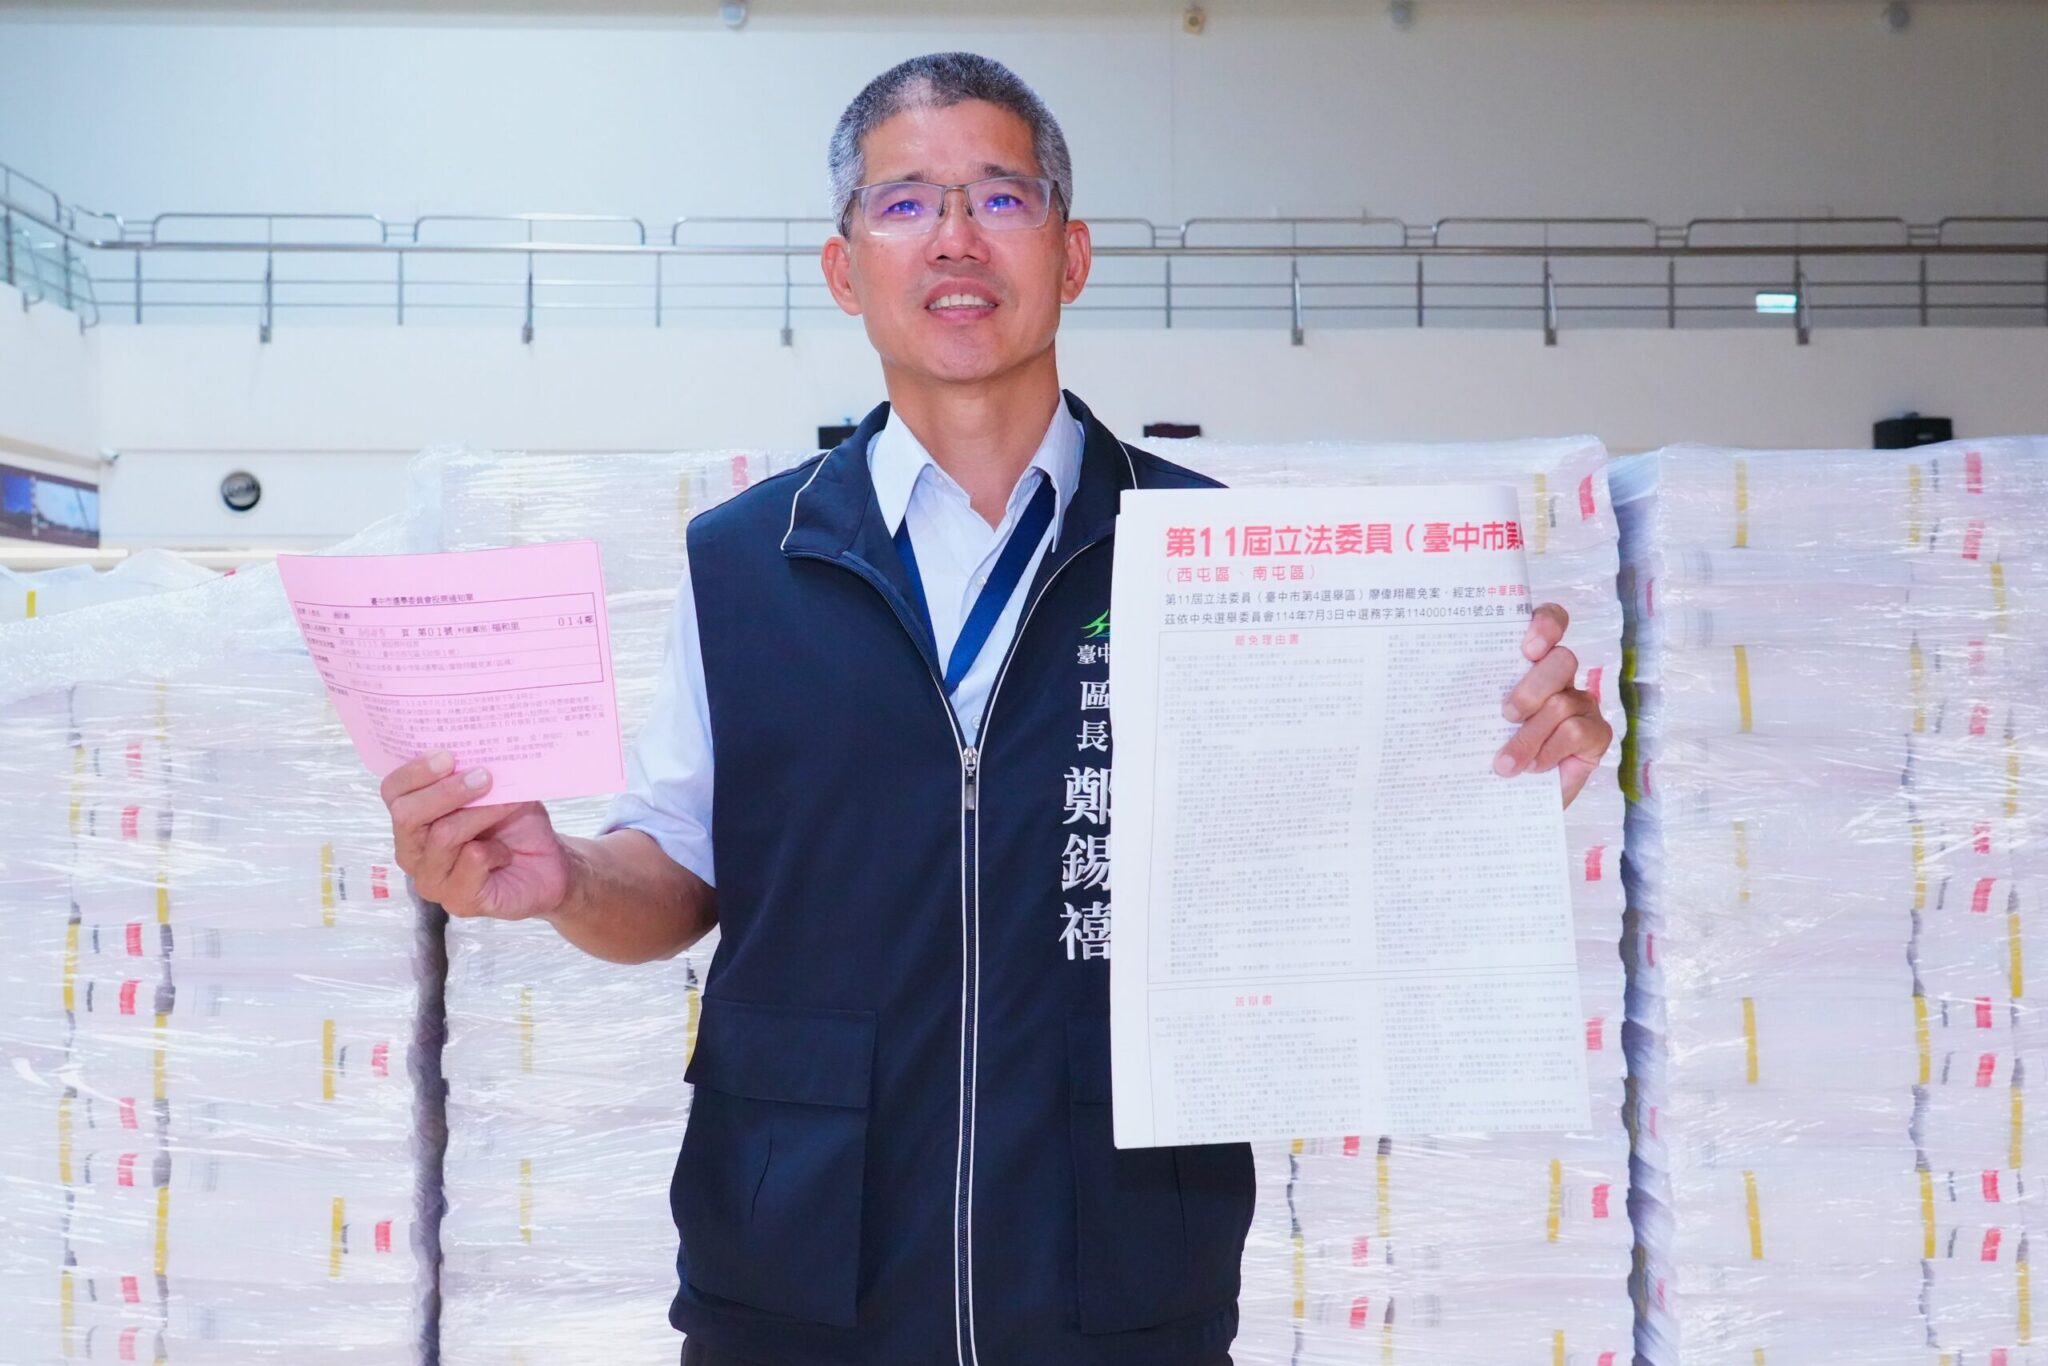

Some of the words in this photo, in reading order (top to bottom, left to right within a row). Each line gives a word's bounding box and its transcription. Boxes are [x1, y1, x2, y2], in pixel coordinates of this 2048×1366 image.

[1166, 520, 1523, 558] 第11屆立法委員（臺中市第
